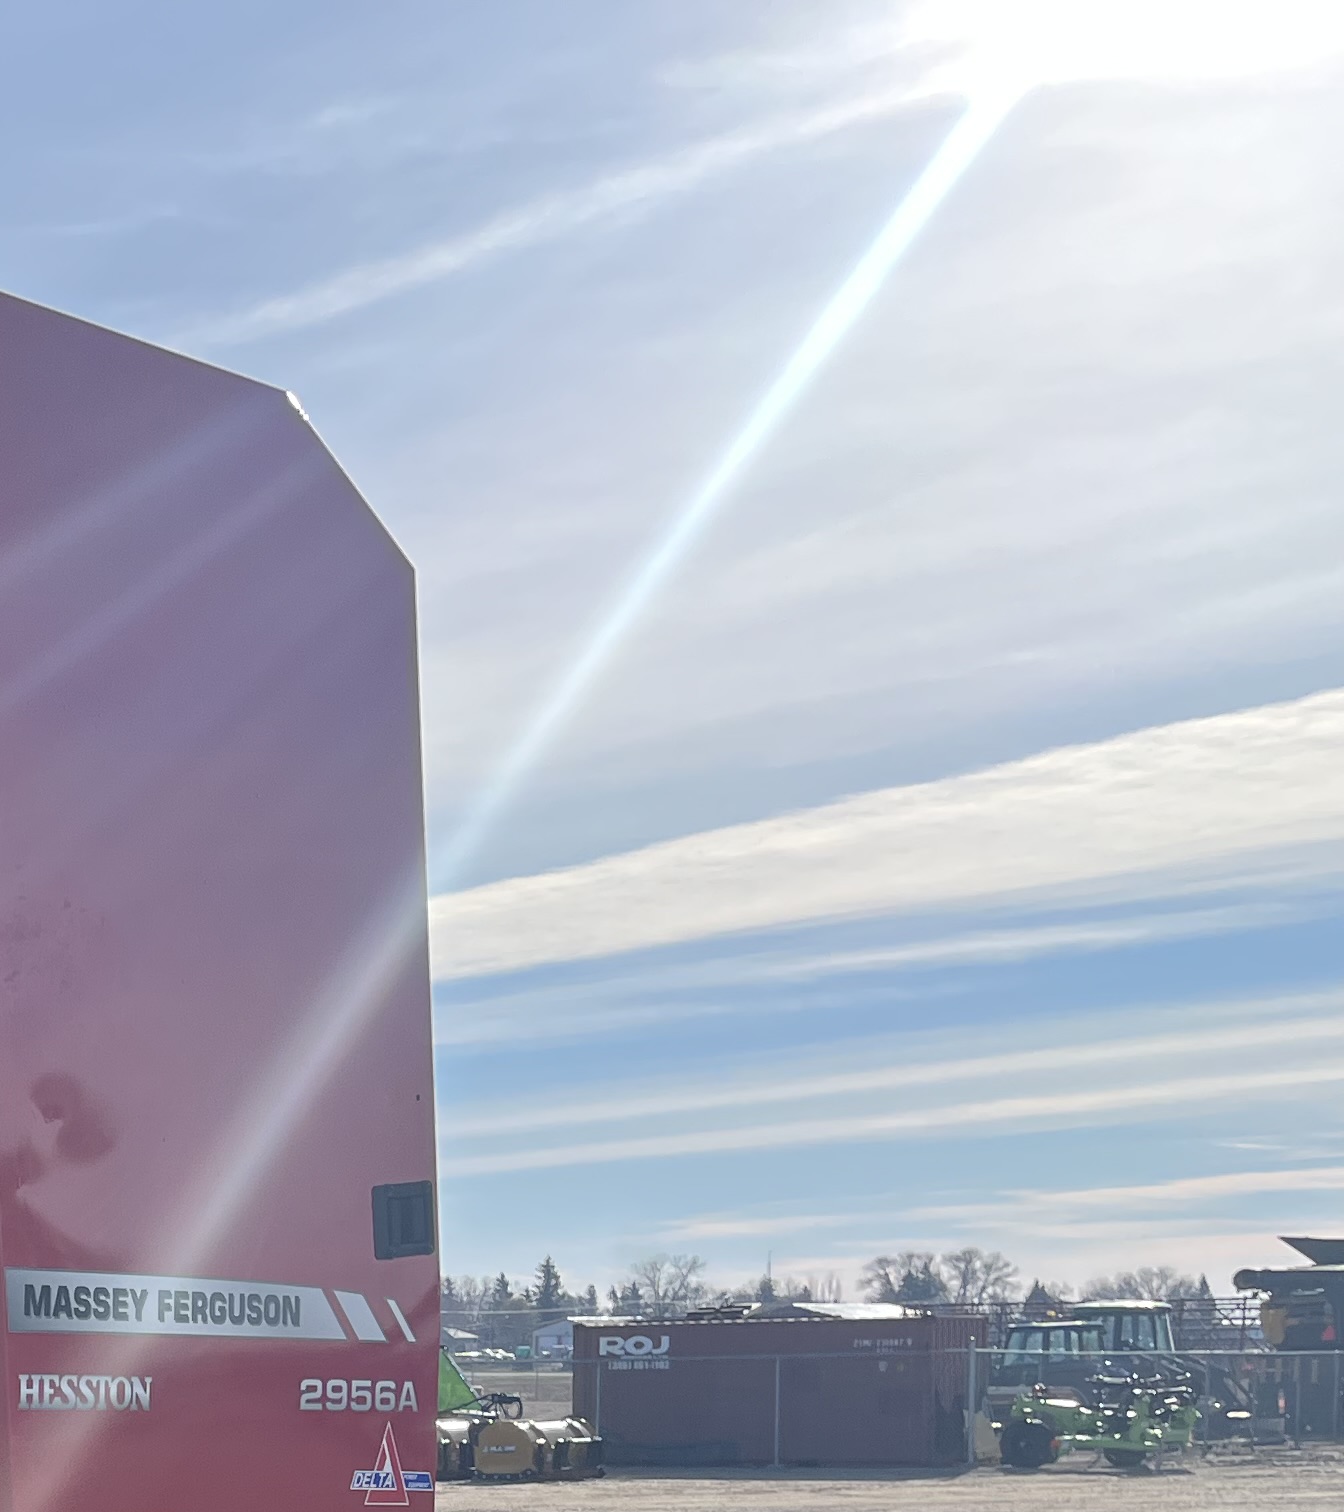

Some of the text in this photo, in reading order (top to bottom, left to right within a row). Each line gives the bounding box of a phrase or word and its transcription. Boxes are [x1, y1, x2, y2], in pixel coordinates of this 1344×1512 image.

[23, 1284, 301, 1327] MASSEY FERGUSON
[599, 1335, 670, 1356] ROJ
[18, 1374, 153, 1411] HESSTON
[299, 1379, 419, 1412] 2956A
[353, 1472, 393, 1488] DELTA
